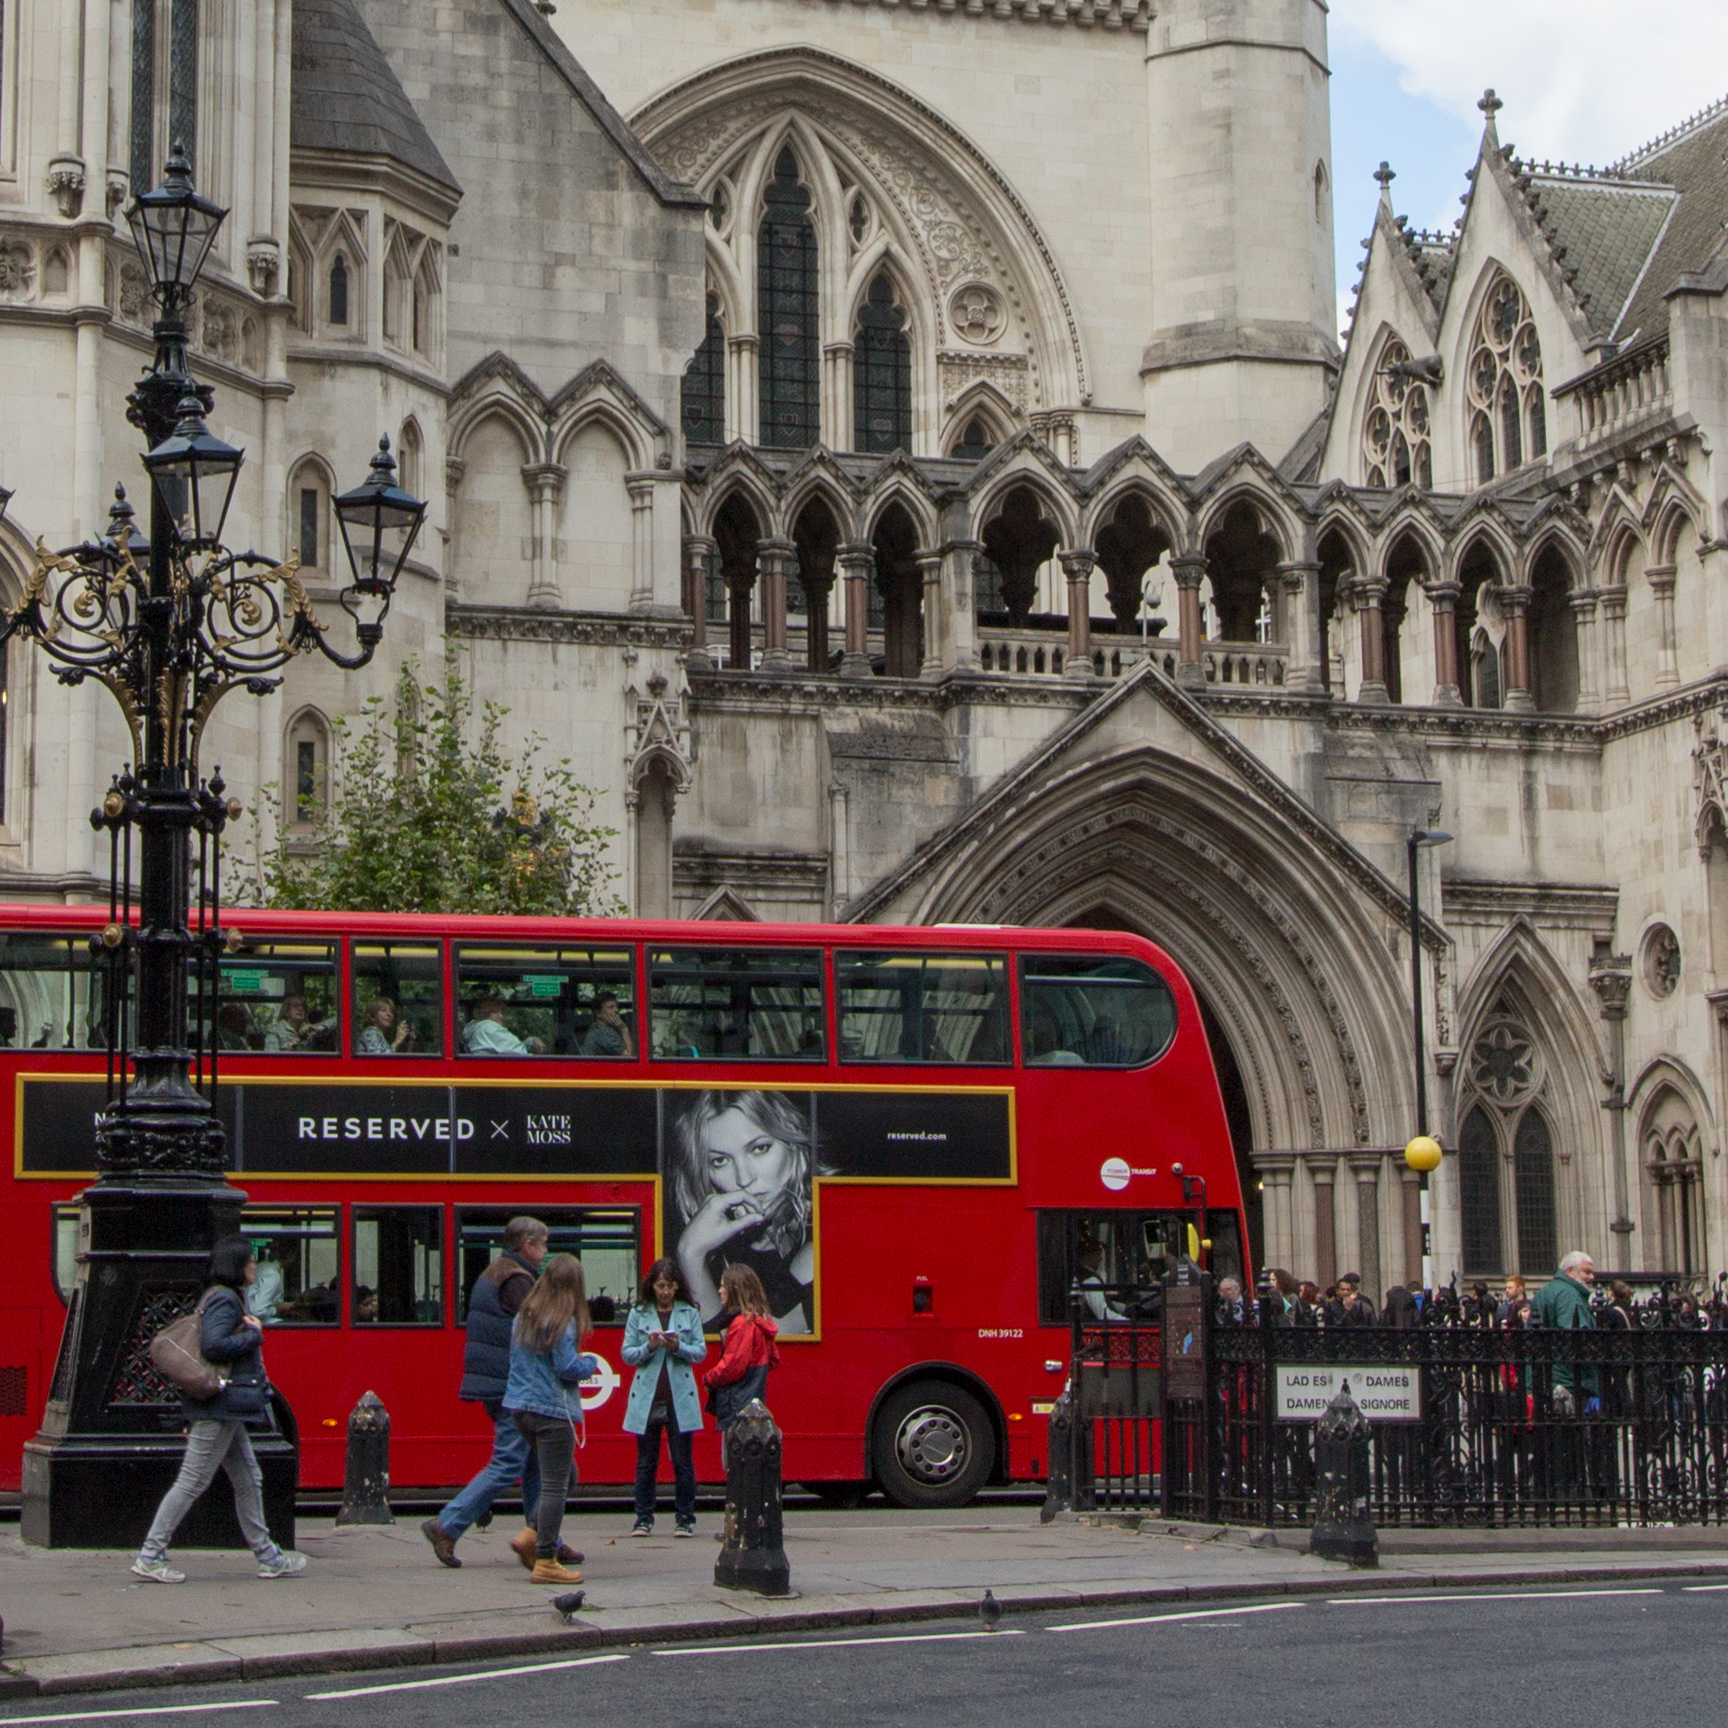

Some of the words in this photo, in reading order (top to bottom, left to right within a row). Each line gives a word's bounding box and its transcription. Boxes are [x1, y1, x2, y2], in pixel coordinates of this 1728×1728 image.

[526, 1114, 571, 1129] KATE
[298, 1117, 475, 1139] RESERVED
[526, 1129, 571, 1144] MOSS
[887, 1130, 947, 1141] reserved.com
[998, 1329, 1024, 1338] 39122
[1365, 1376, 1409, 1387] DAMES
[1360, 1399, 1410, 1410] SIGNORE
